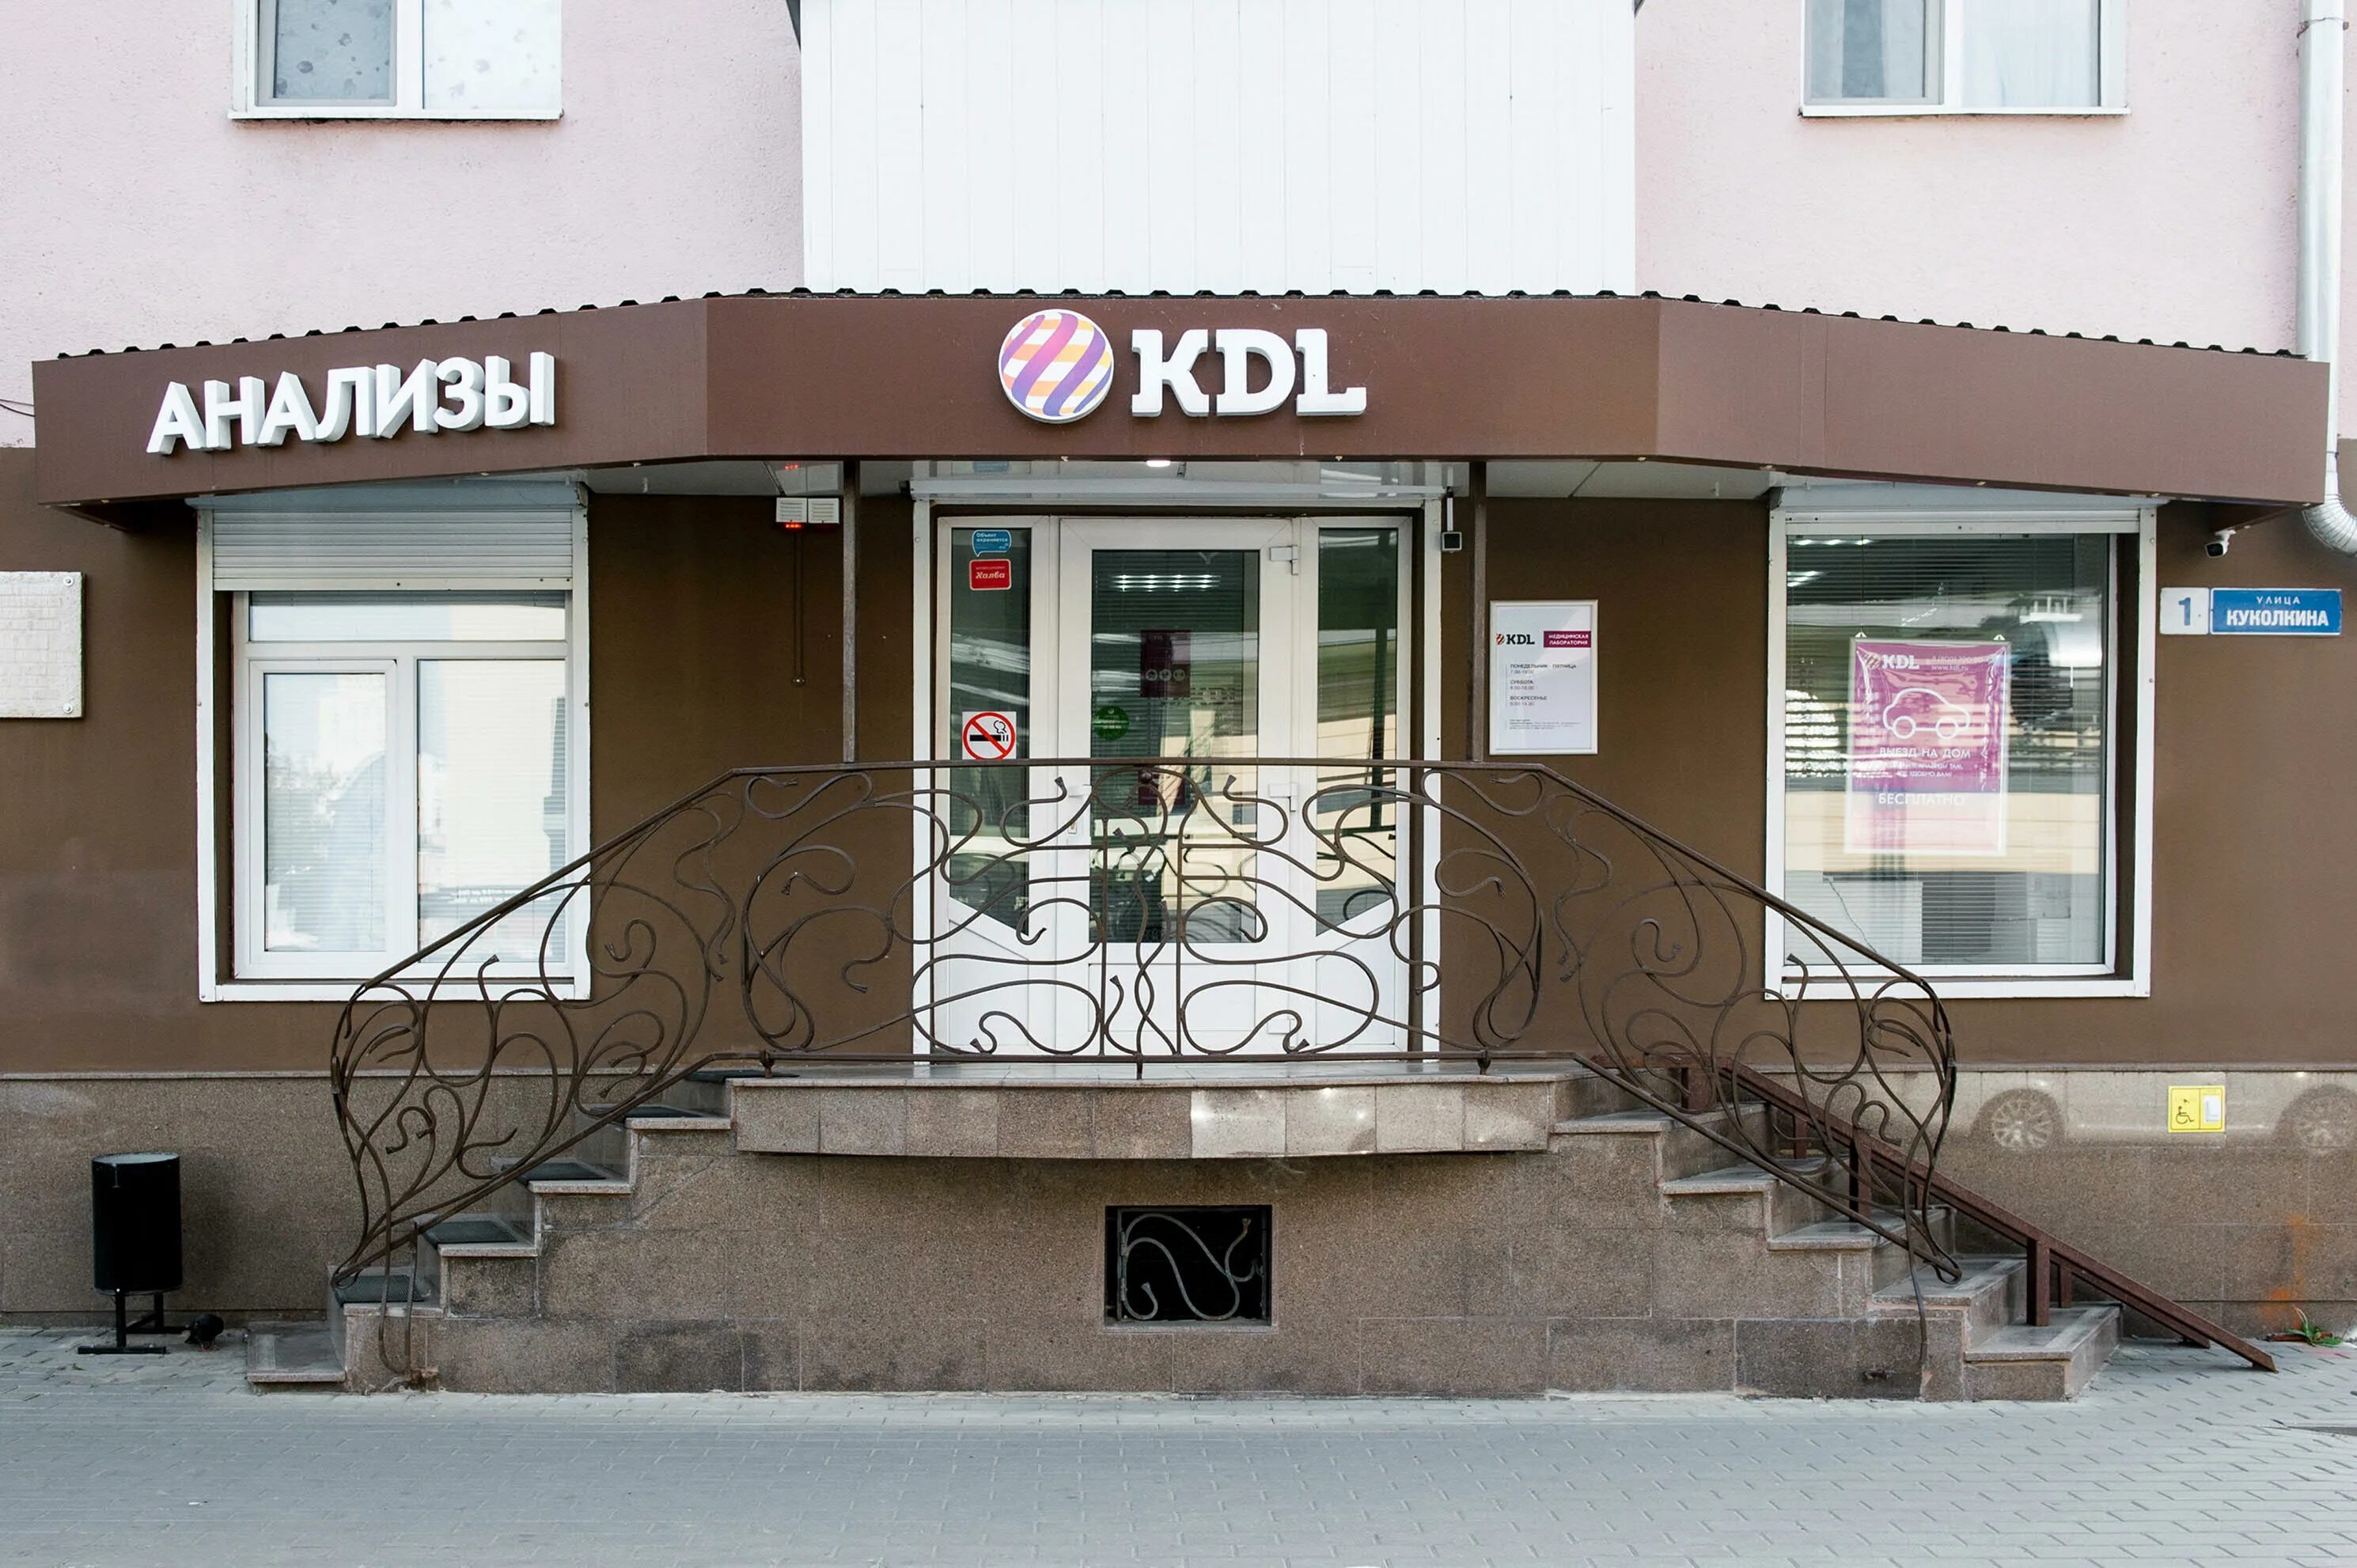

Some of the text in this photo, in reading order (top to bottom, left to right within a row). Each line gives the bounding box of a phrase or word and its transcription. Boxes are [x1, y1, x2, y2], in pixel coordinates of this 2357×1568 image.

[1131, 328, 1367, 417] KDL
[146, 351, 555, 455] АНАЛИЗЫ
[2257, 596, 2300, 605] УЛИЦА
[2178, 597, 2191, 626] 1
[2226, 610, 2329, 627] КУКОЛКИНА
[1506, 634, 1535, 645] KDL
[1882, 654, 1919, 670] KDL
[1879, 748, 1970, 759] ВЫЕЗД НА ДОМ
[1878, 793, 1965, 805] БЕСПЛАТНО
